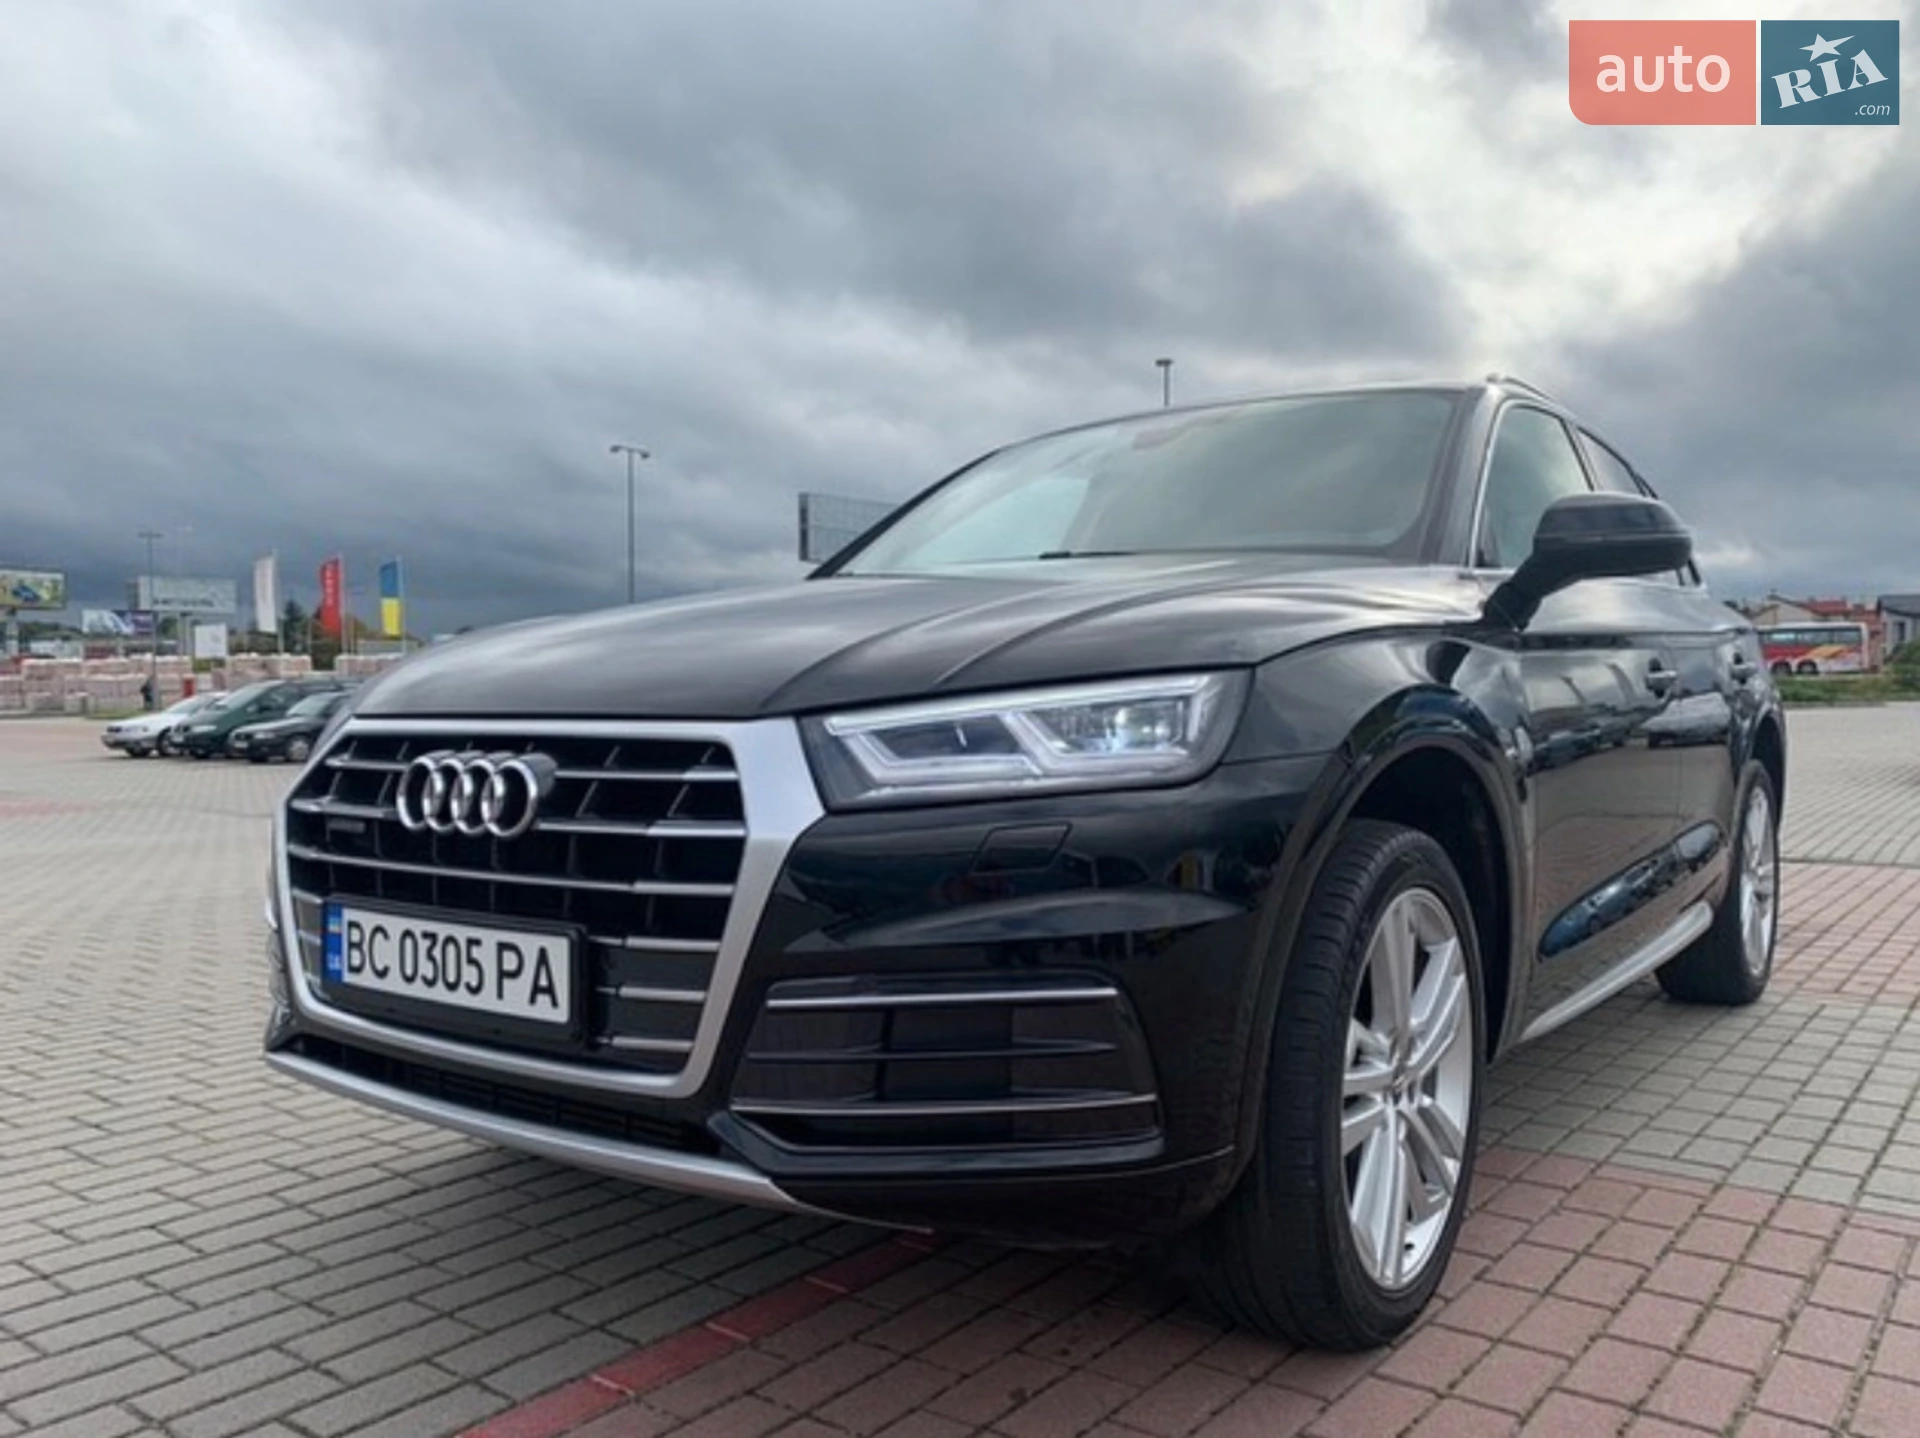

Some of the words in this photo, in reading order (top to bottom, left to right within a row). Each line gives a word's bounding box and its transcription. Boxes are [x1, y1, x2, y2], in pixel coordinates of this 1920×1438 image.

[347, 920, 391, 979] BC
[399, 928, 484, 996] 0305
[496, 941, 559, 1009] PA
